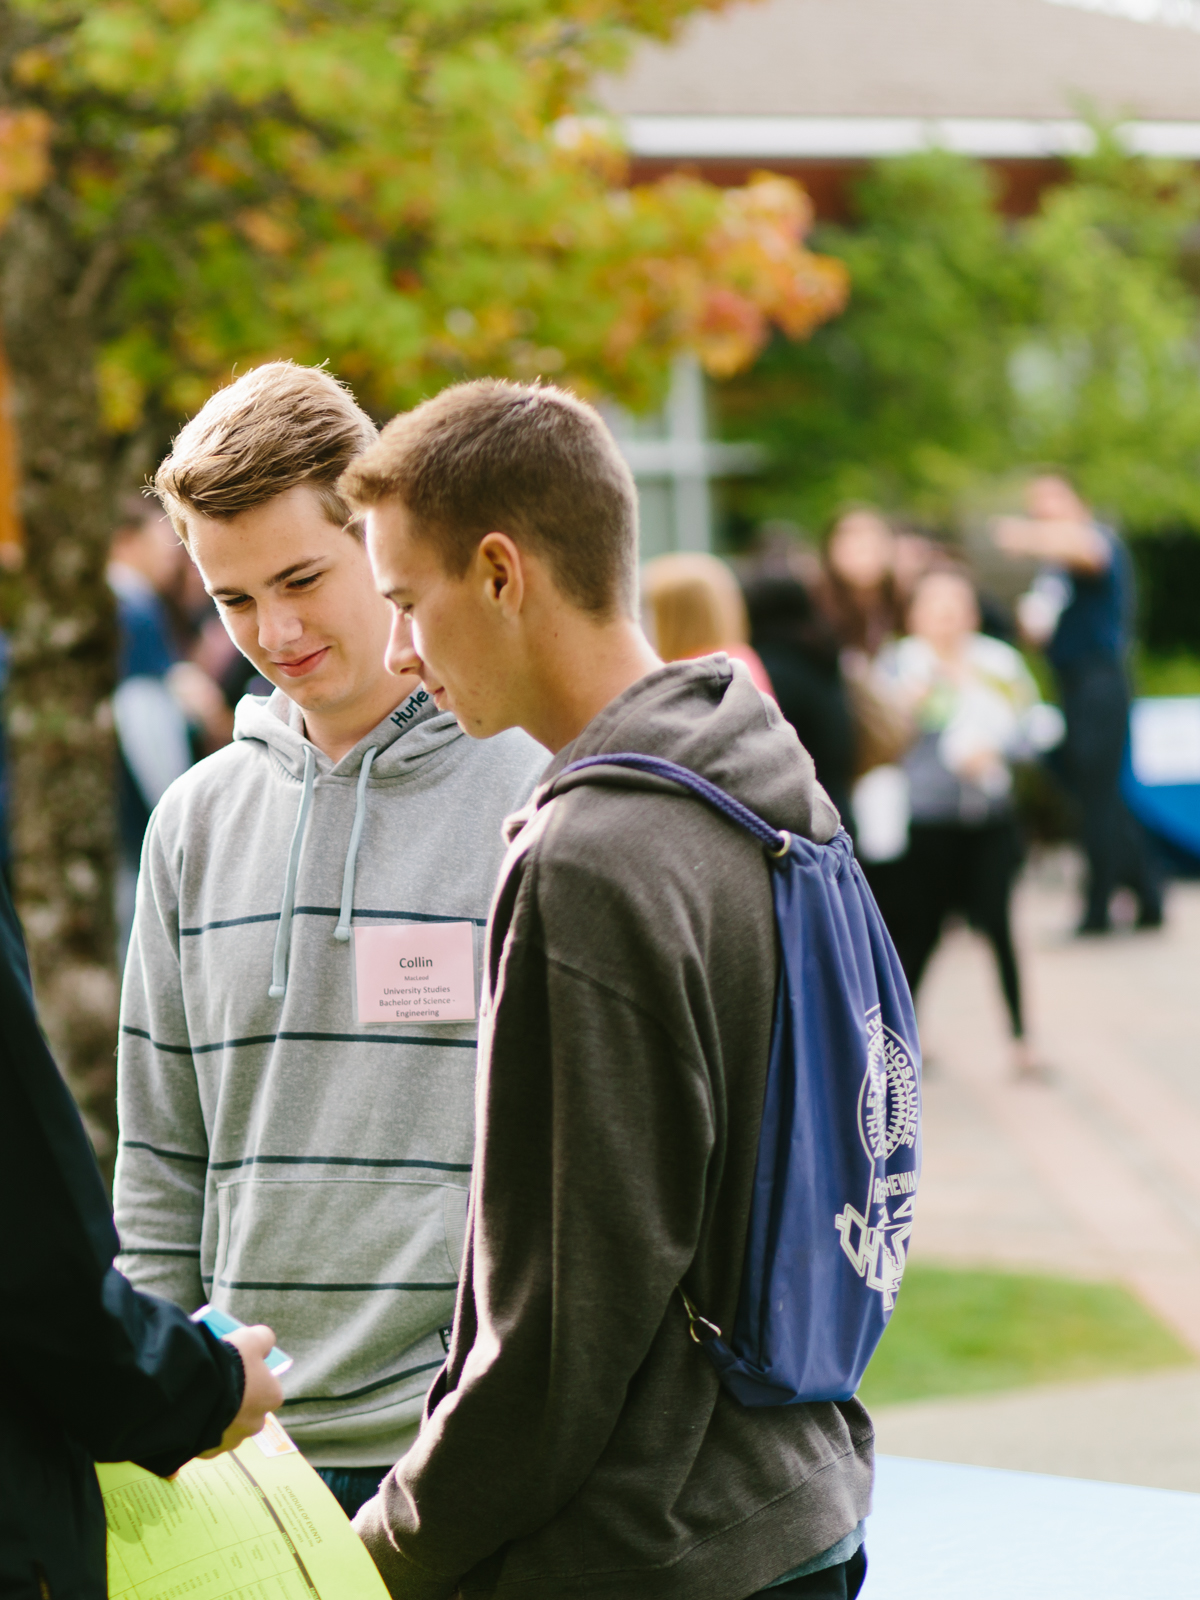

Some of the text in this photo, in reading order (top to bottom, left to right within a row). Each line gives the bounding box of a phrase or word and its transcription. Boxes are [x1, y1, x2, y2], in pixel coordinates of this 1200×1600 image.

[390, 690, 429, 728] Hurle
[399, 957, 433, 968] Collin
[383, 987, 422, 995] University
[379, 999, 411, 1007] Bachelor
[423, 997, 451, 1005] Science
[396, 1010, 440, 1018] Engineering
[884, 1034, 918, 1149] NOSAUNEE
[283, 1484, 323, 1543] SCHEDULE OF EVENTS
[280, 1531, 296, 1553] LOCATION
